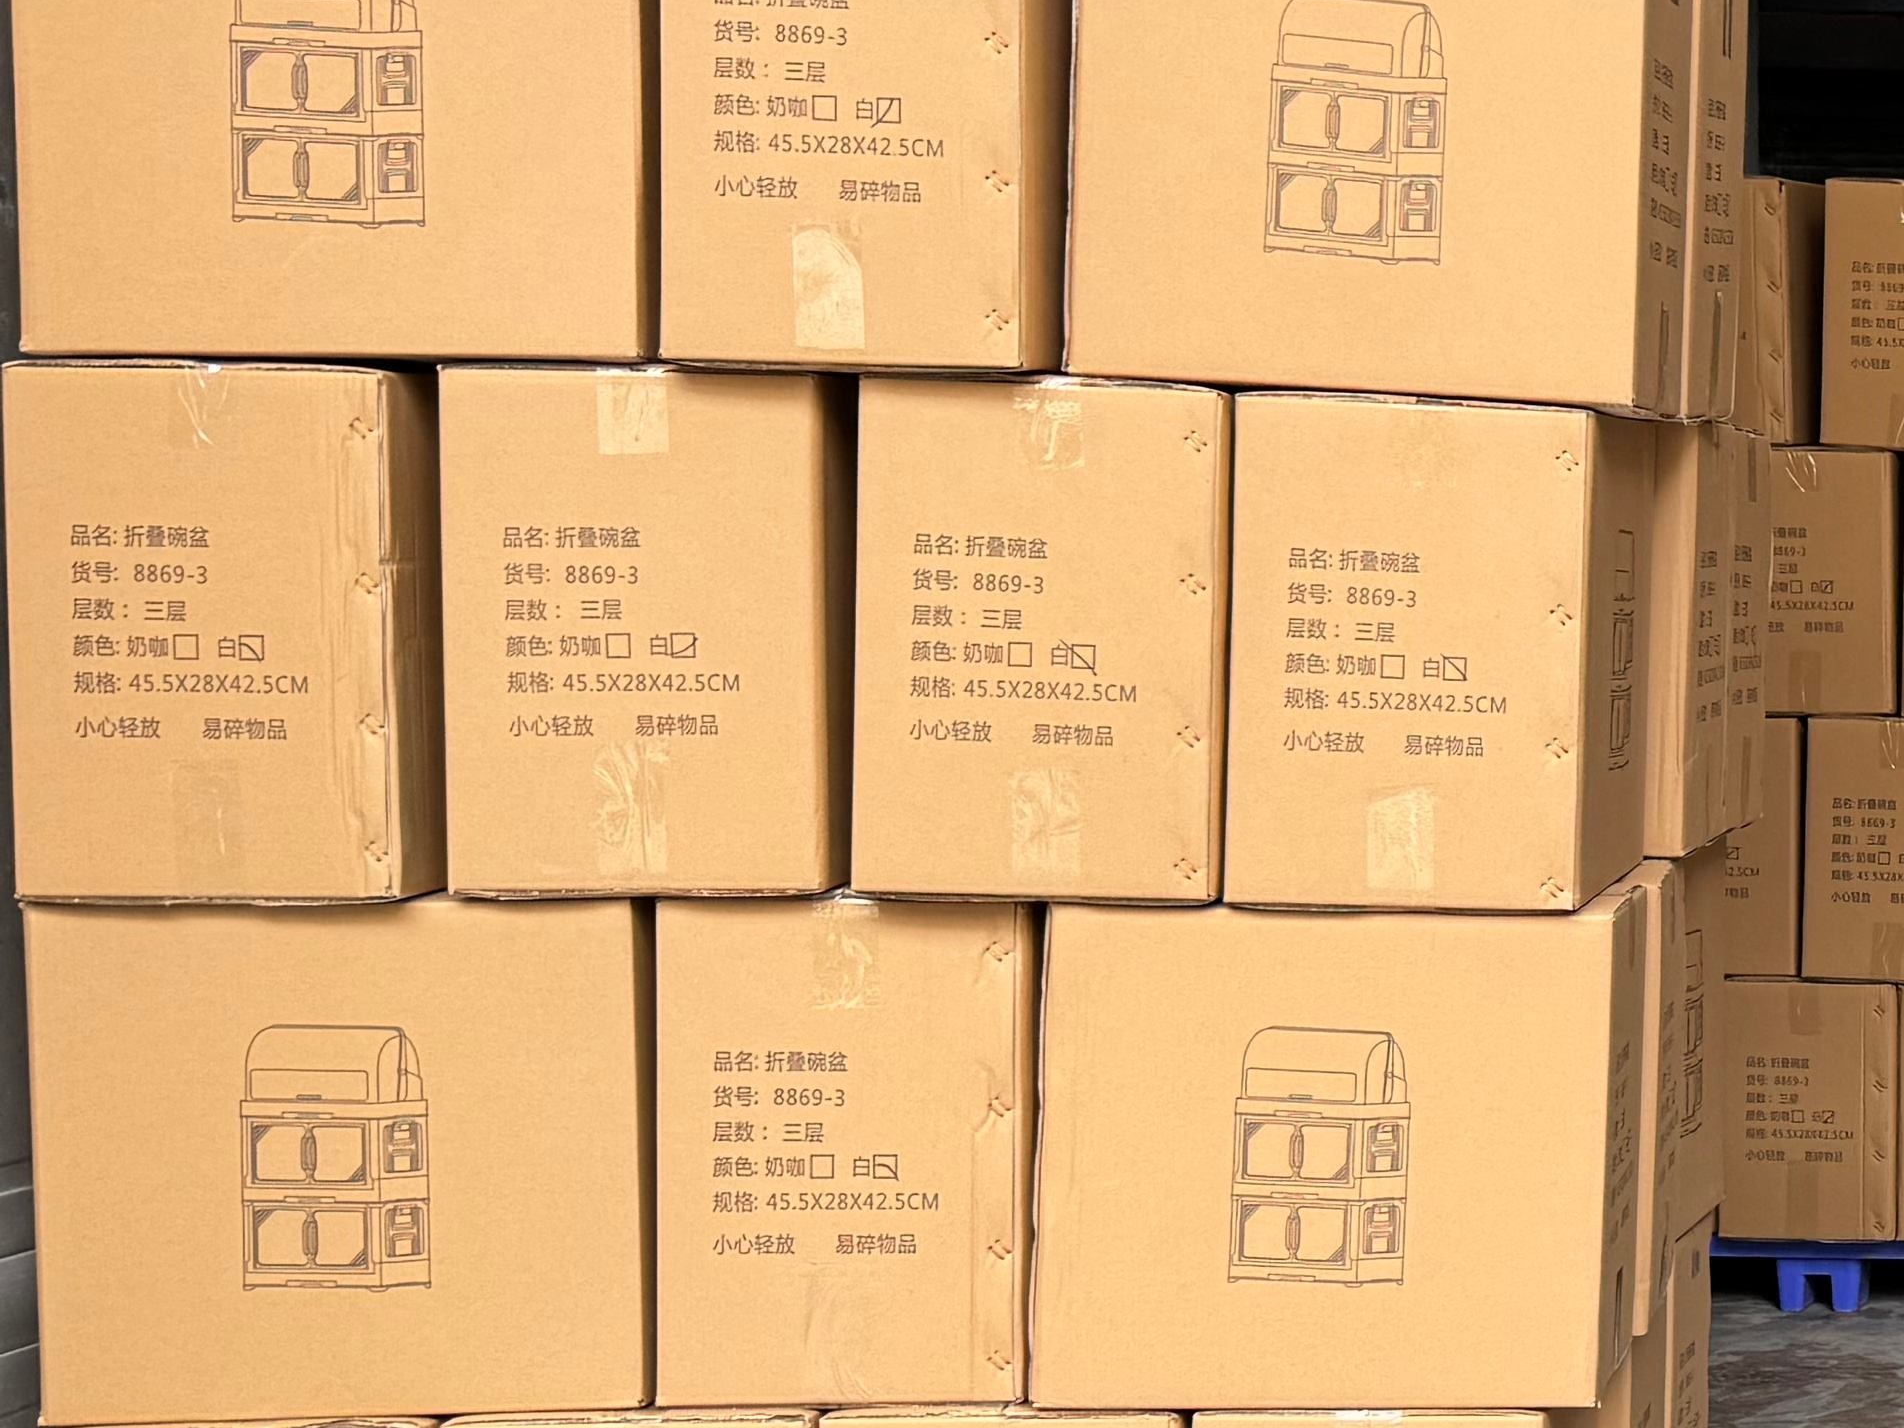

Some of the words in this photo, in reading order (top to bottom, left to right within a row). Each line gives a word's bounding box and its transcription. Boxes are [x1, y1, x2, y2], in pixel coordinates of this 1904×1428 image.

[775, 24, 847, 46] 8869-3
[784, 61, 825, 83] 三层
[766, 95, 807, 117] 奶咖
[856, 98, 873, 120] 白
[769, 134, 943, 157] 45.5X28X42.5CM
[714, 175, 797, 199] 小心轻放
[839, 180, 921, 202] 易碎物品
[134, 563, 207, 584] 8869-3
[1347, 586, 1416, 608] 8869-3
[144, 600, 186, 622] 三层
[1354, 622, 1394, 643] 三层
[127, 635, 168, 657] 奶咖
[217, 636, 236, 658] 白
[1336, 654, 1376, 675] 奶咖
[1422, 657, 1440, 678] 白
[130, 673, 308, 693] 45.5X28X42.5CM
[1337, 691, 1506, 713] 45.5X28X42.5CM
[76, 716, 160, 738] 小心轻放
[203, 718, 286, 739] 易碎物品
[1284, 730, 1364, 753] 小心轻放
[1404, 735, 1483, 756] 易碎物品
[774, 1087, 844, 1107] 8869-3
[783, 1122, 823, 1143] 三层
[765, 1156, 805, 1176] 奶咖
[852, 1155, 870, 1176] 白
[767, 1192, 938, 1210] 45.5X28X42.5CM
[713, 1233, 794, 1255] 小心轻放
[836, 1233, 916, 1254] 易碎物品
